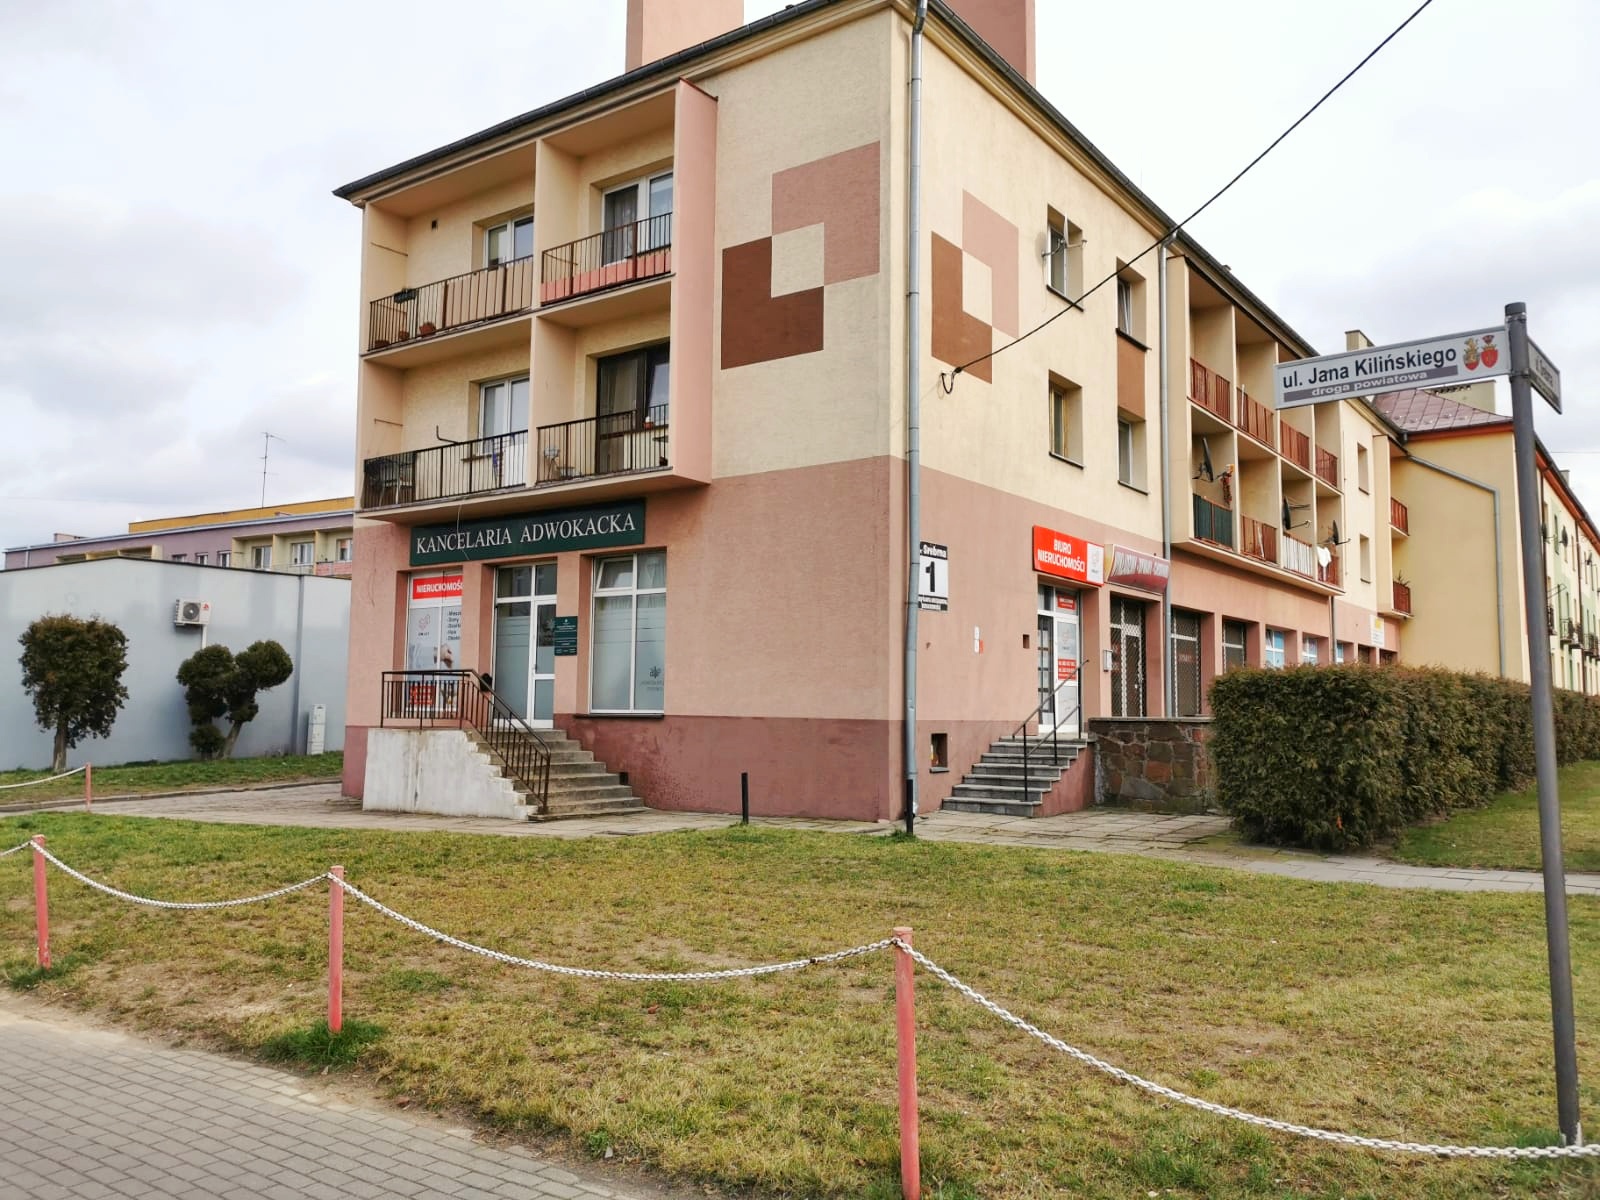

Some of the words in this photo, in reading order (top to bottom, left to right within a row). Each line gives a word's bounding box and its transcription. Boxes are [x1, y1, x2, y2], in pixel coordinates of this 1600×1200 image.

[1283, 370, 1303, 388] ul.
[1308, 366, 1349, 384] Jana
[1355, 348, 1456, 376] Kilińskiego
[1312, 384, 1350, 396] droga
[1353, 372, 1427, 391] powiatowa
[416, 527, 512, 554] KANCELARIA
[520, 513, 636, 543] ADWOKACKA
[1053, 539, 1072, 555] BIURO
[1037, 548, 1086, 573] NIERUCHOMOŚCI
[925, 561, 935, 593] 1
